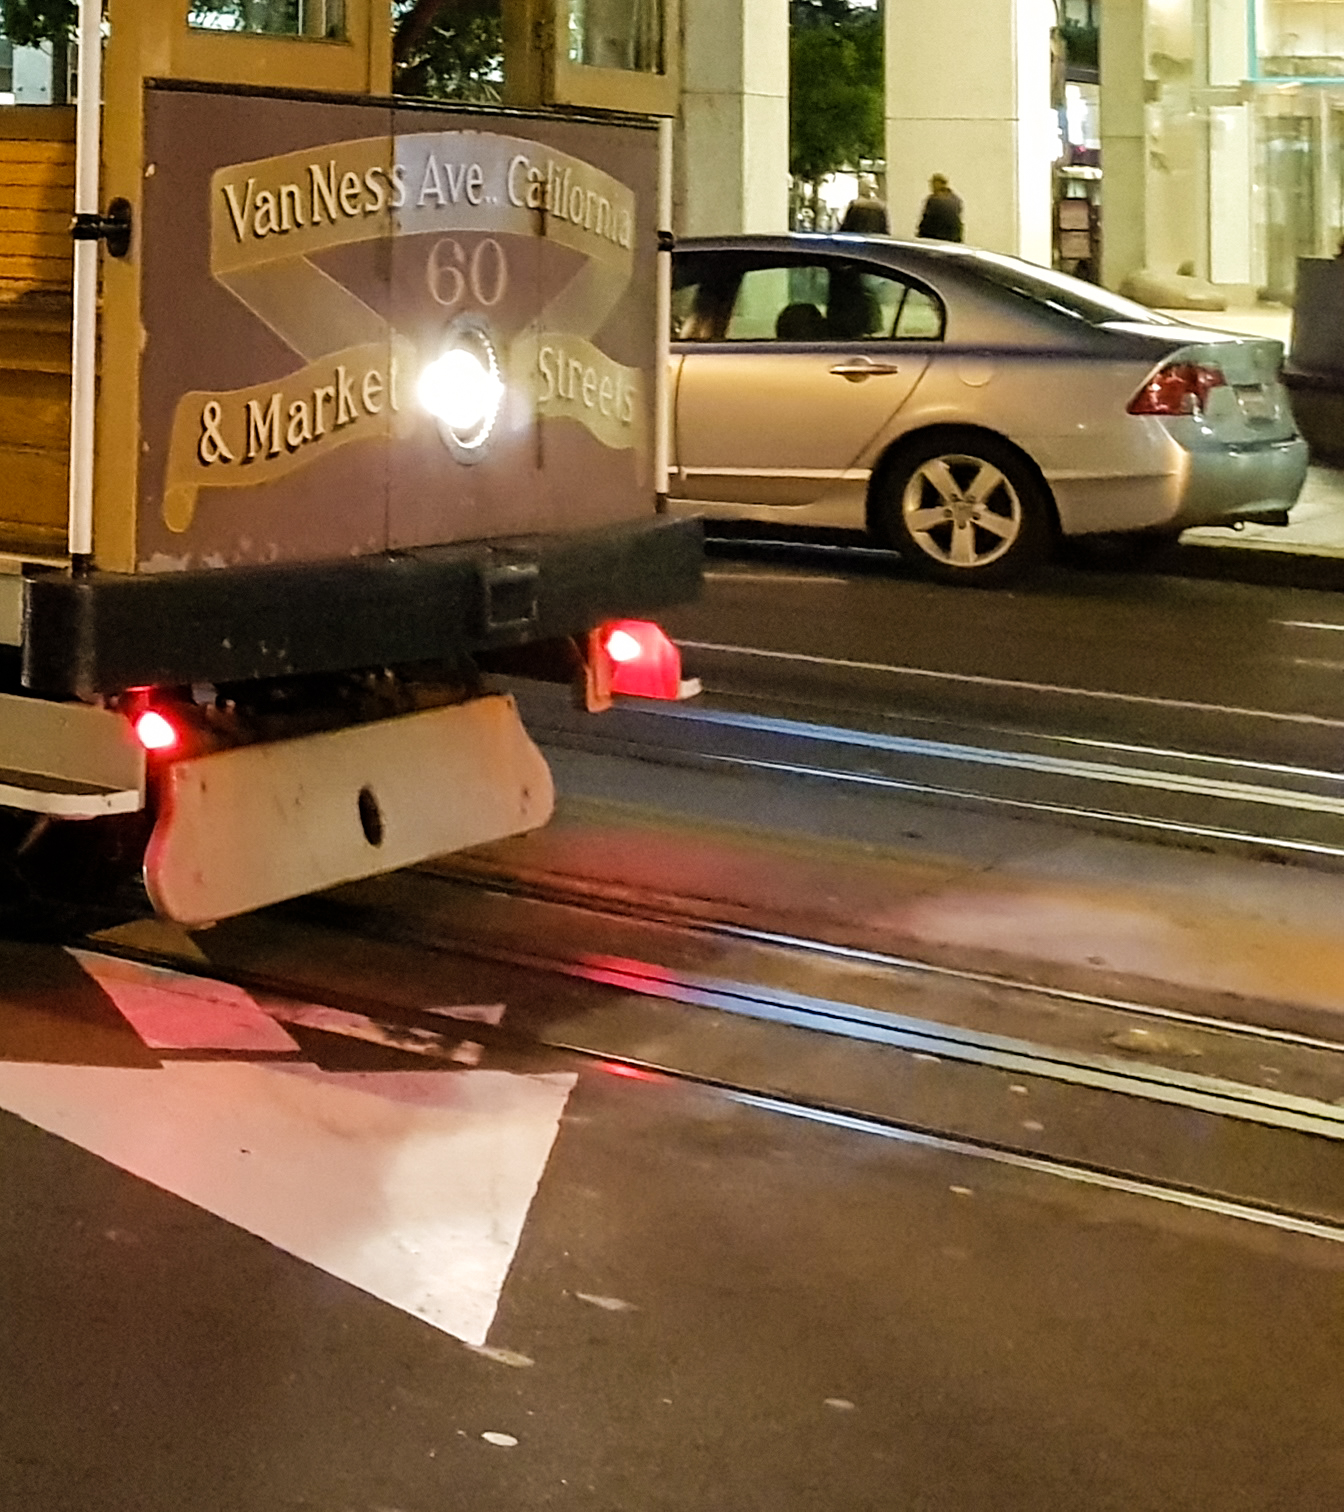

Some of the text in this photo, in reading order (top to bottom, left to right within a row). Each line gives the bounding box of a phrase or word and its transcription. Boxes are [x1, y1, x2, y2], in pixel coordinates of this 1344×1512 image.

[222, 177, 305, 243] Van
[307, 160, 408, 225] Ness
[508, 154, 632, 249] California
[426, 236, 509, 306] 60
[197, 346, 638, 466] & Market Streets
